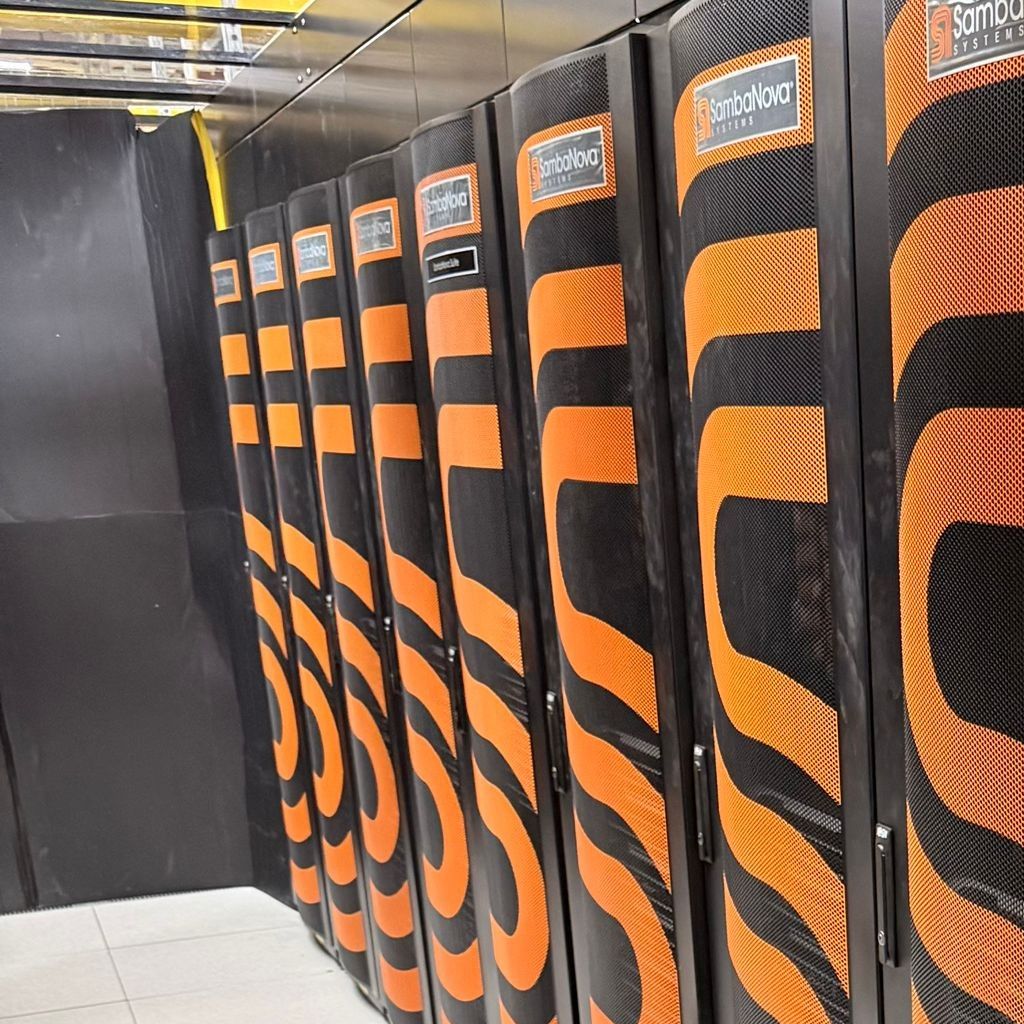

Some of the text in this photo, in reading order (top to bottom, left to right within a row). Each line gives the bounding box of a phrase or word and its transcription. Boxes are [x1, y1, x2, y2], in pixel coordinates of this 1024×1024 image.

[953, 24, 1024, 56] SYSTEMS
[710, 81, 792, 124] SambaNova
[539, 147, 599, 178] SambaNova
